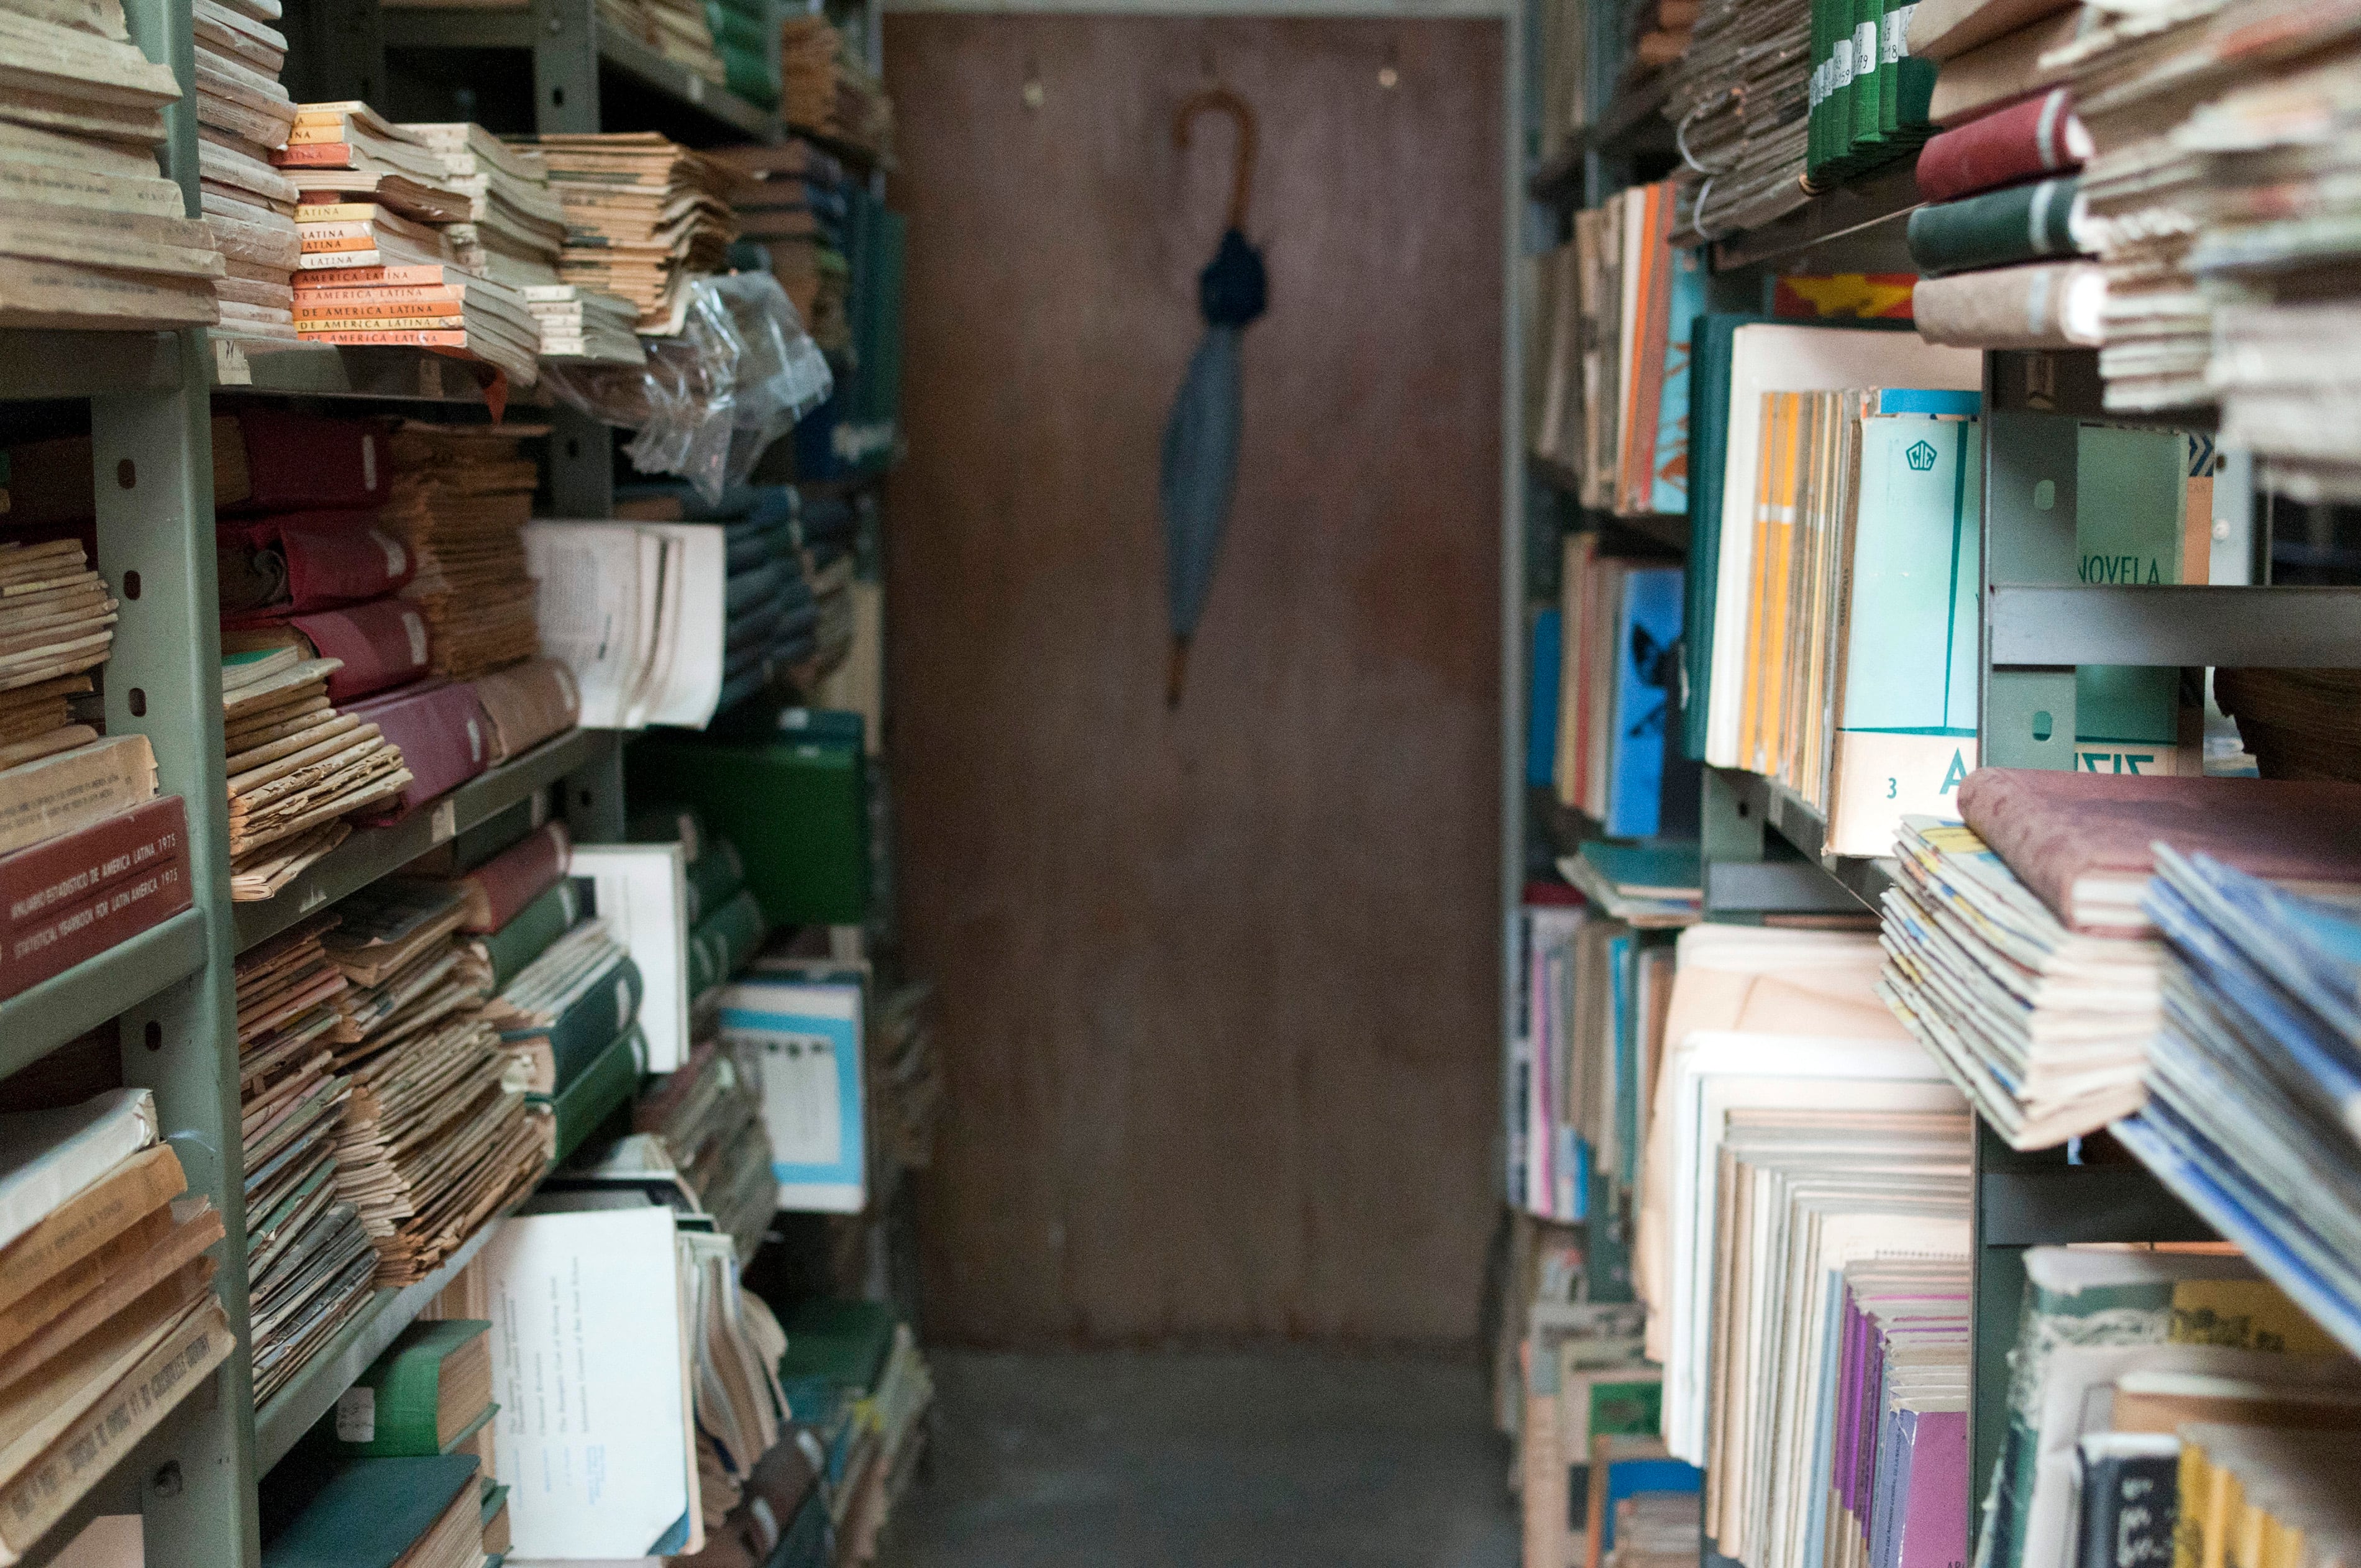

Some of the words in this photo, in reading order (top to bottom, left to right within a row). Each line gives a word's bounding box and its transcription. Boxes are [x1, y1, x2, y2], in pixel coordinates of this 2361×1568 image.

[302, 230, 344, 239] LATINA
[305, 240, 341, 249] ATINA
[311, 256, 353, 266] LATINA
[366, 271, 408, 281] LATINA
[316, 290, 372, 299] AMERICA
[380, 288, 422, 298] LATINA
[302, 309, 317, 317] DE
[326, 306, 382, 316] AMERICA
[390, 304, 432, 314] LATINA
[300, 322, 316, 330] DE
[324, 319, 380, 329] AMERICA
[388, 317, 431, 327] LATINA
[331, 333, 386, 342] AMERICA
[395, 332, 437, 342] LATINA
[1886, 777, 1897, 800] 3
[89, 867, 100, 885] DE
[101, 854, 130, 878] AMERICA
[132, 842, 155, 865] LATINA
[158, 833, 176, 852] 1975
[161, 867, 178, 885] 1975
